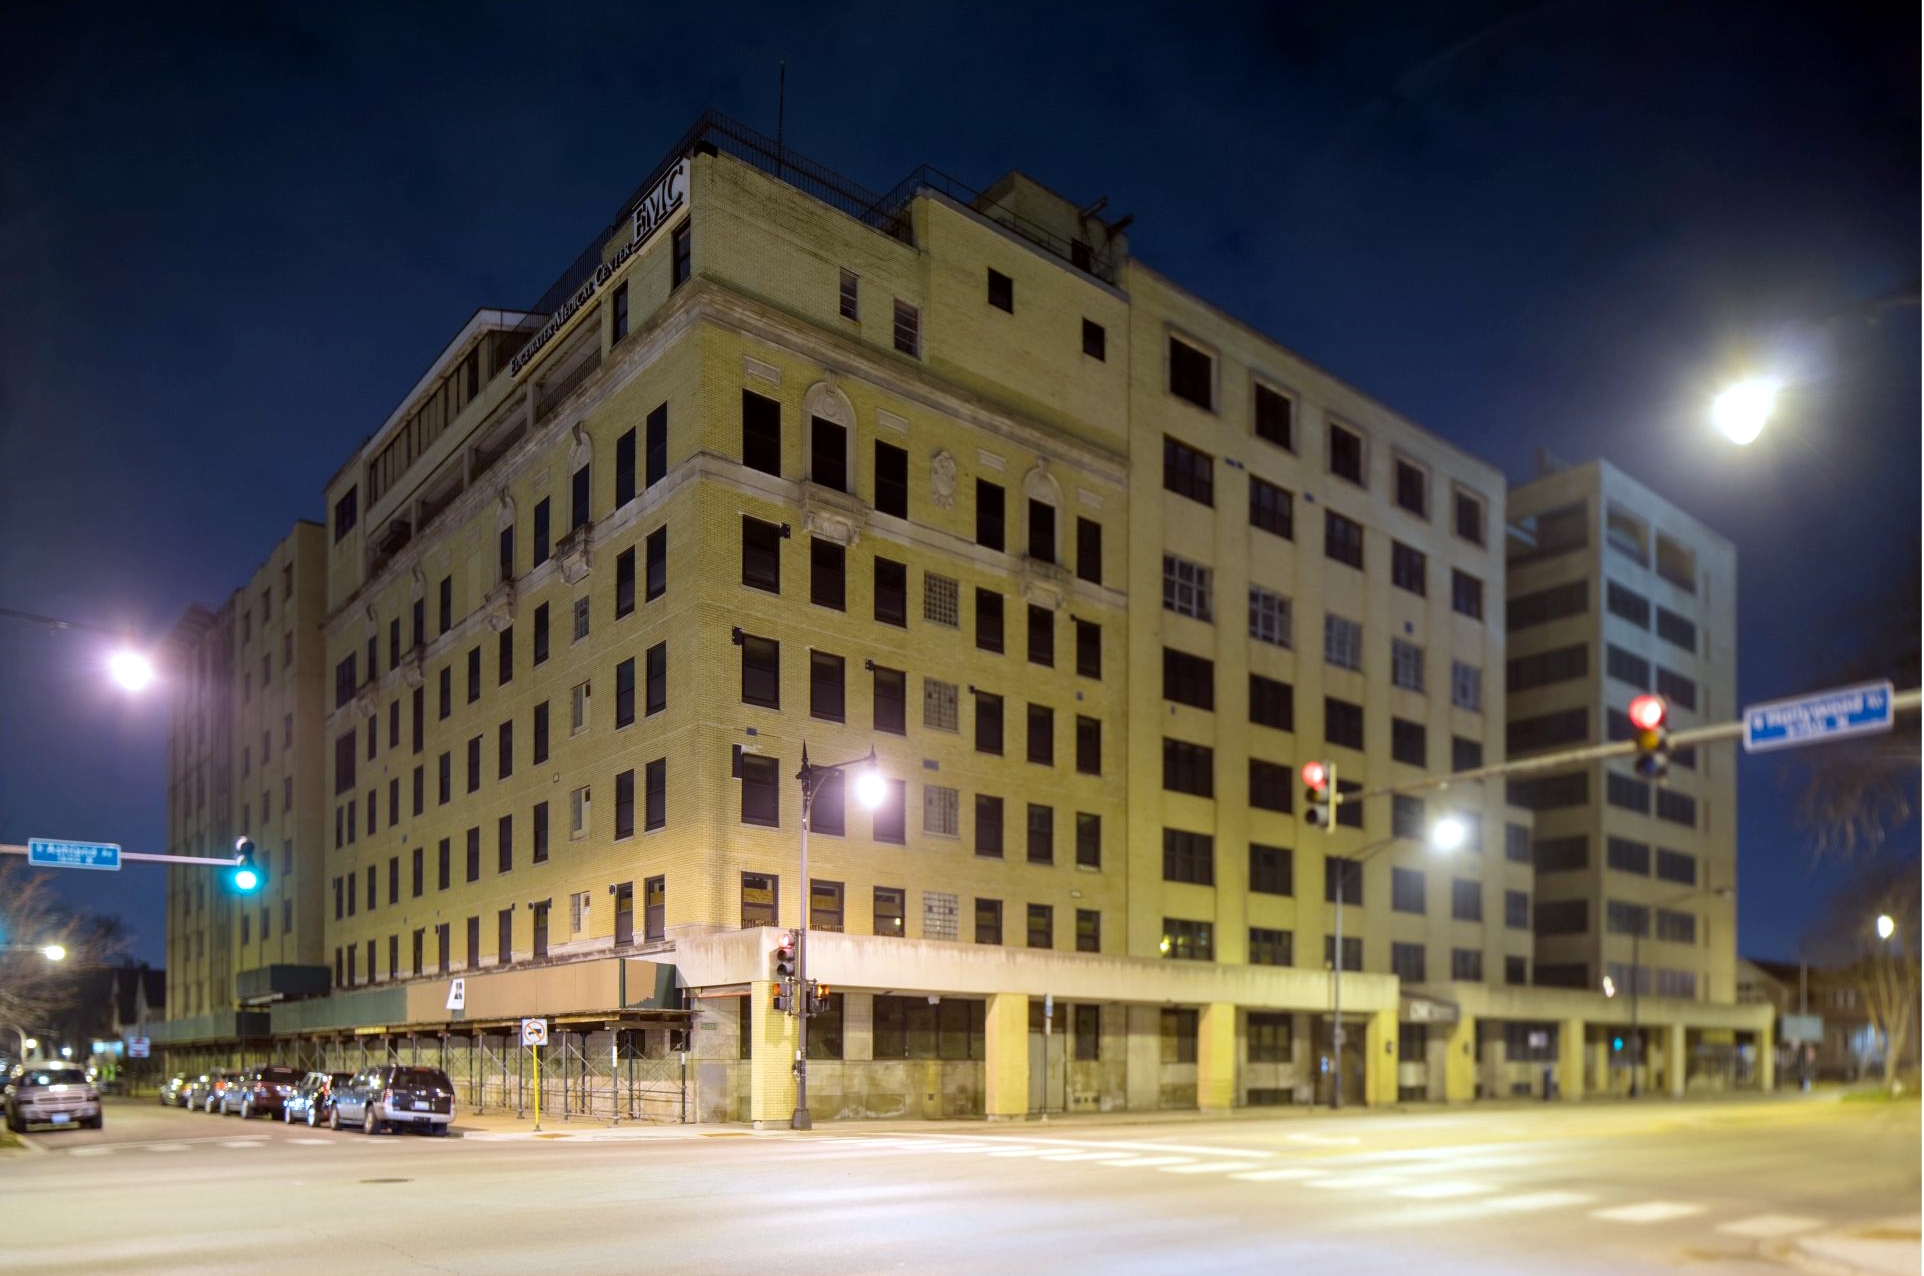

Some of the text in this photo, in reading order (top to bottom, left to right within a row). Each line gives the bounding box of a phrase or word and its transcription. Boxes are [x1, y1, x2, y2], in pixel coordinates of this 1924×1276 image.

[632, 164, 684, 243] EMC
[510, 240, 633, 378] EDGEWATER MEDICAL CENTER
